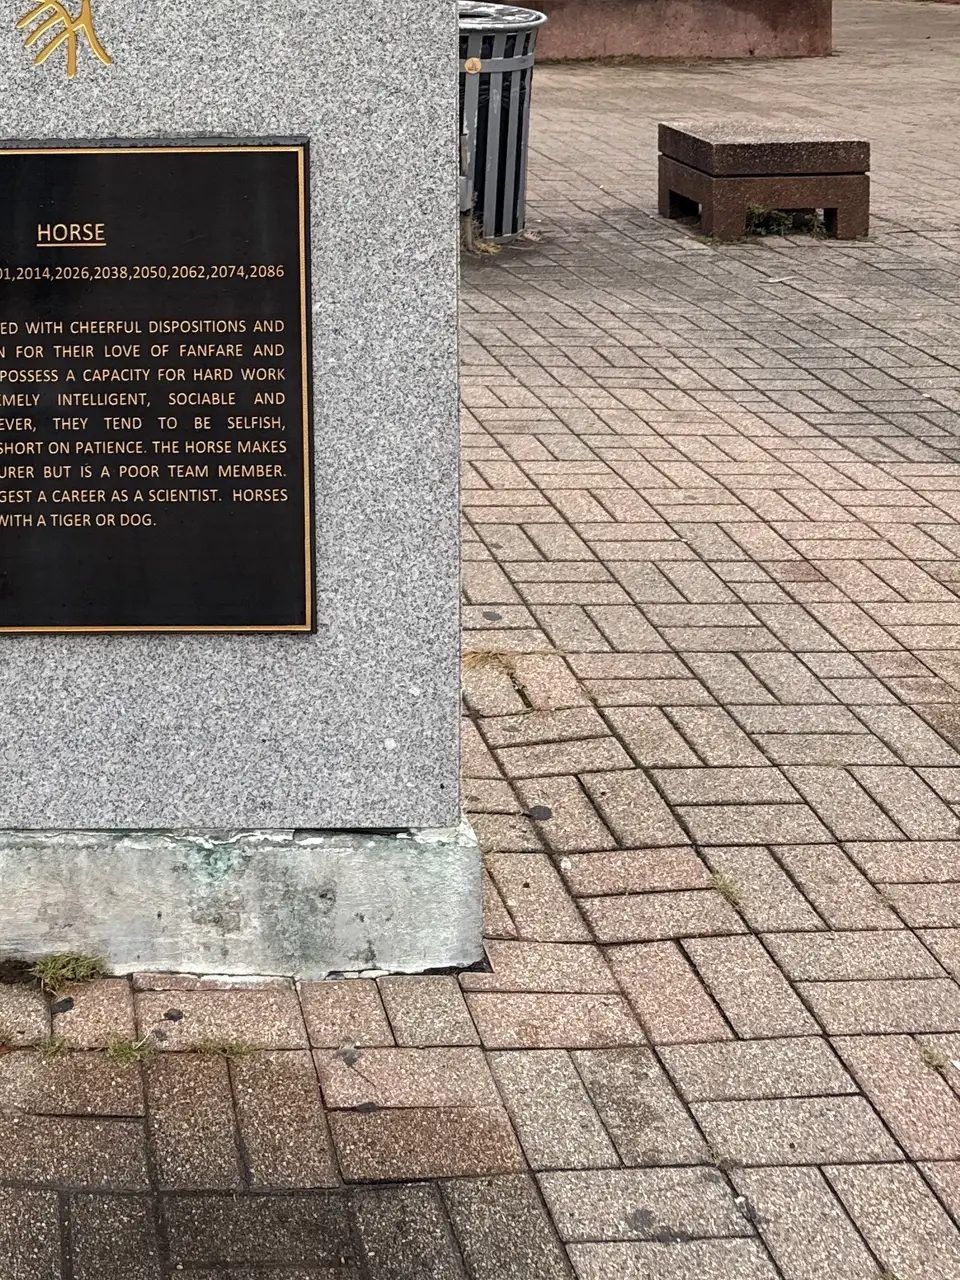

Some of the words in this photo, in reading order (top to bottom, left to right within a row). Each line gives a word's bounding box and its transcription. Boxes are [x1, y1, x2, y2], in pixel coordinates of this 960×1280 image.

[37, 223, 106, 242] HORSE
[24, 322, 63, 335] WITH
[69, 320, 143, 335] CHEERFUL
[148, 319, 247, 334] DISPOSITIONS
[252, 320, 285, 333] AND
[15, 345, 44, 359] FOR
[52, 344, 95, 358] THEIR
[104, 344, 141, 358] LOVE
[150, 345, 170, 358] OF
[179, 343, 243, 358] FANFARE
[252, 344, 285, 357] AND
[0, 369, 59, 383] POSSESS
[65, 369, 76, 382] A
[82, 368, 151, 382] CAPACITY
[157, 368, 186, 382] FOR
[193, 368, 234, 380] HARD
[240, 368, 286, 381] WORK
[57, 392, 151, 409] INTELLIGENT,
[168, 392, 236, 406] SOCIABLE
[253, 393, 286, 405] AND
[52, 417, 89, 431] THEY
[103, 416, 143, 430] TEND
[157, 417, 178, 430] TO
[194, 416, 212, 429] BE
[227, 416, 286, 432] SELFISH,
[48, 442, 70, 455] ON
[75, 440, 147, 454] PATIENCE.
[151, 441, 180, 454] THE
[185, 440, 232, 453] HORSE
[237, 440, 287, 454] MAKES
[43, 466, 72, 479] BUT
[80, 463, 93, 478] IS
[100, 465, 111, 478] A
[119, 465, 160, 478] POOR
[167, 464, 209, 478] TEAM
[218, 464, 287, 478] MEMBER.
[36, 491, 48, 503] A
[51, 489, 106, 503] CAREER
[110, 489, 129, 502] AS
[133, 490, 144, 503] A
[148, 488, 222, 502] SCIENTIST.
[232, 488, 289, 502] HORSES
[36, 515, 47, 527] A
[49, 513, 92, 527] TIGER
[95, 513, 116, 526] OR
[120, 513, 157, 527] DOG.
